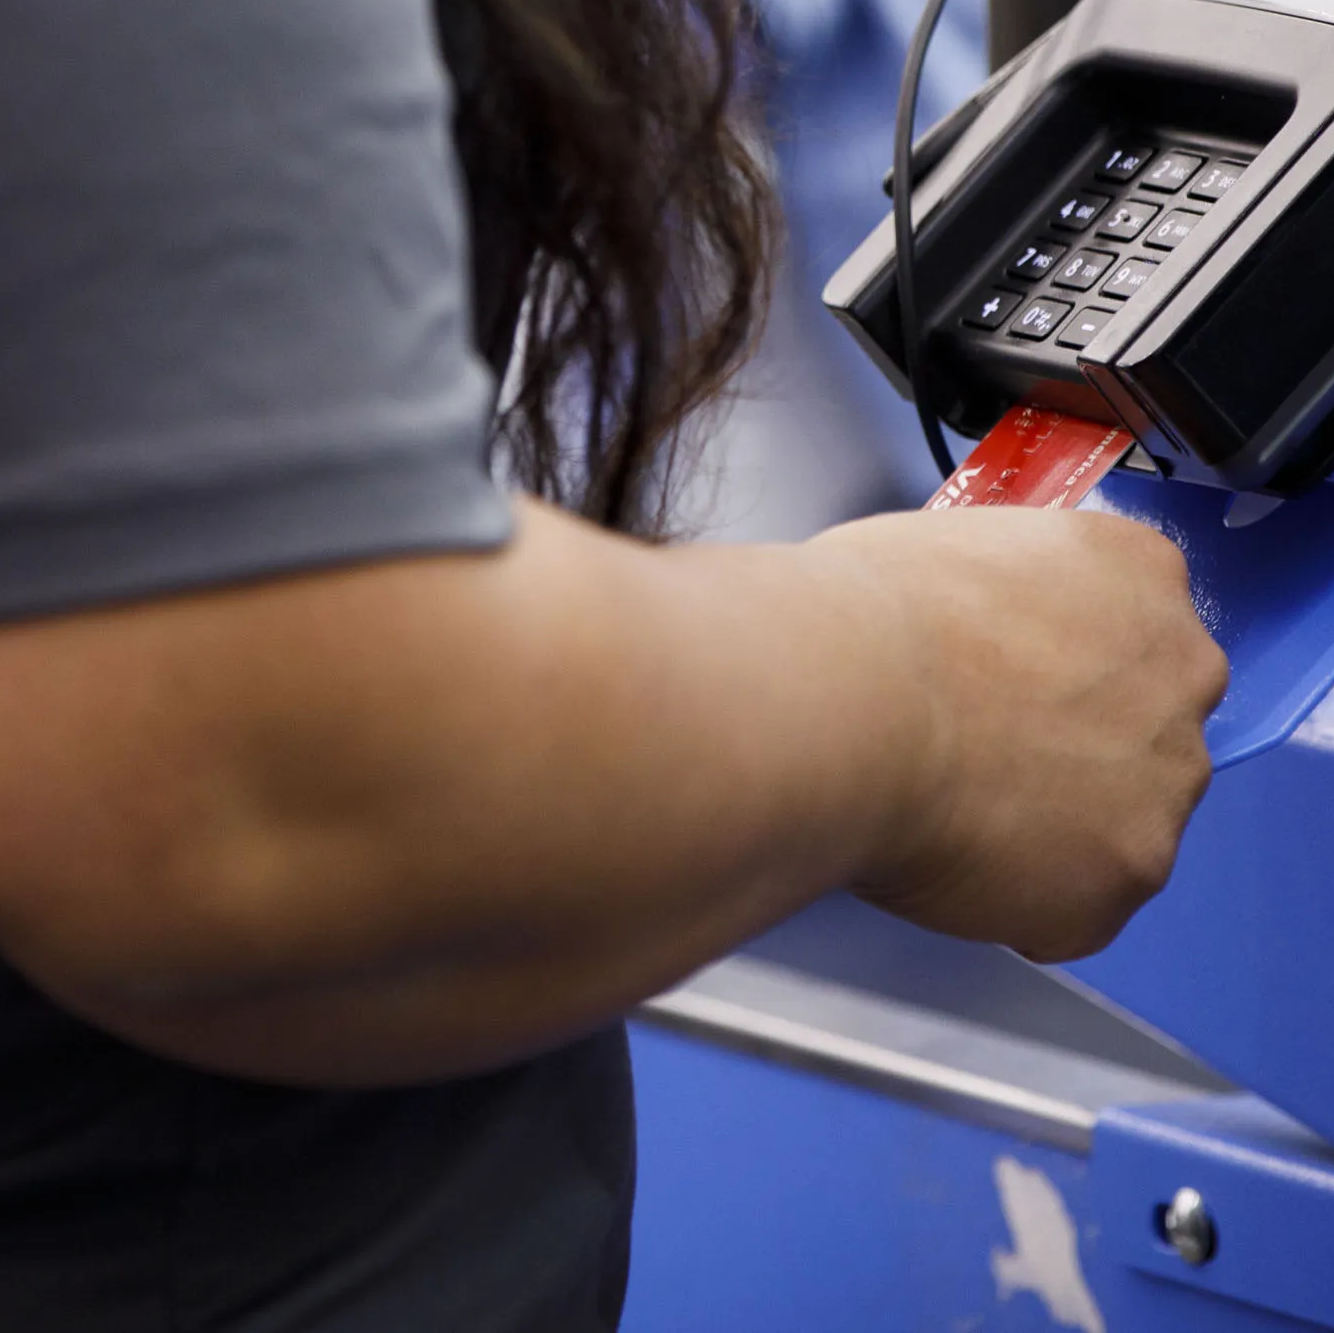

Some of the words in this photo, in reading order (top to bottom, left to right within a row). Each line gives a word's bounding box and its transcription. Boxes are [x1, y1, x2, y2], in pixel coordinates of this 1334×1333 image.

[1104, 149, 1123, 170] 1
[1152, 159, 1171, 179] 2
[1200, 168, 1221, 188] 3
[1060, 199, 1078, 220] 4
[1107, 208, 1127, 227] 5
[1157, 219, 1175, 238] 6
[1017, 247, 1038, 268] 7
[1064, 257, 1083, 278] 8
[1112, 267, 1132, 287] 9
[1065, 425, 1121, 486] merica
[930, 462, 987, 510] VIS
